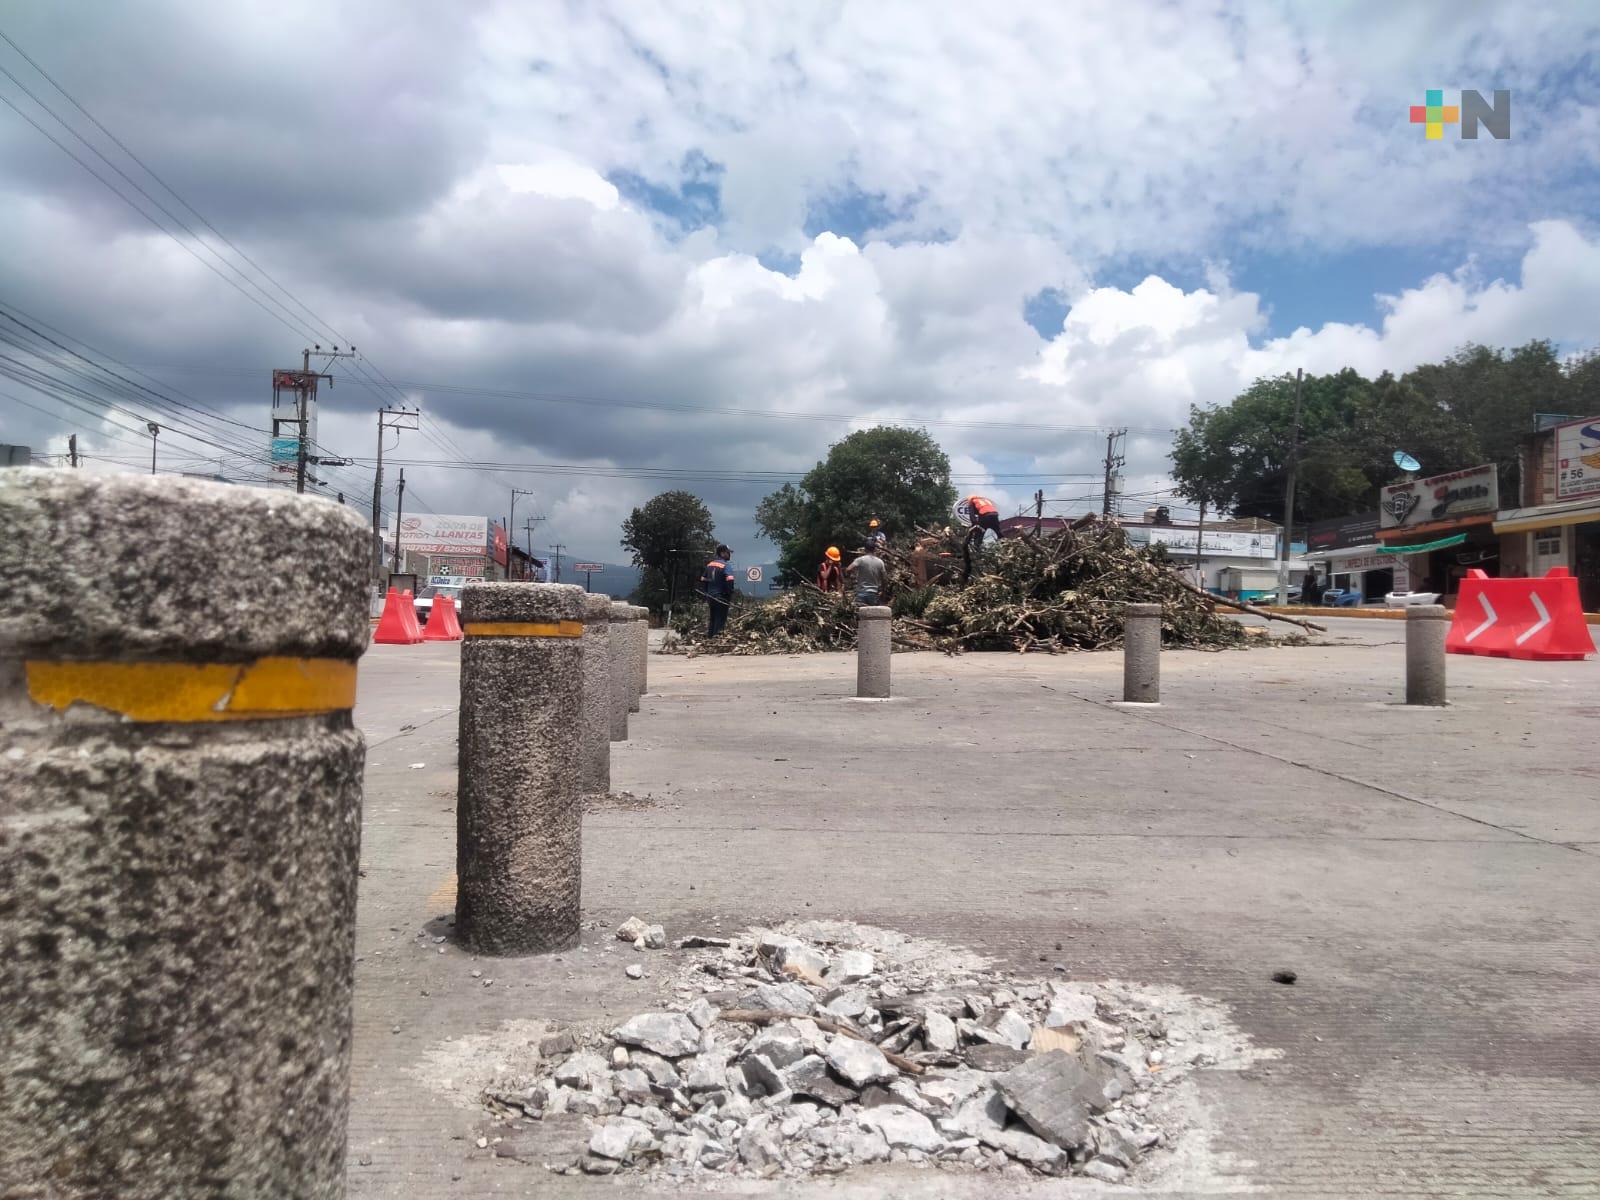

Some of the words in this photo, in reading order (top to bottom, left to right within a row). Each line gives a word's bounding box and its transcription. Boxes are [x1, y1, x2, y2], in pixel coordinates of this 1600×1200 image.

[1570, 468, 1584, 479] 56
[436, 520, 467, 530] ZONA
[469, 522, 484, 531] DE
[433, 530, 484, 540] LLANTAS
